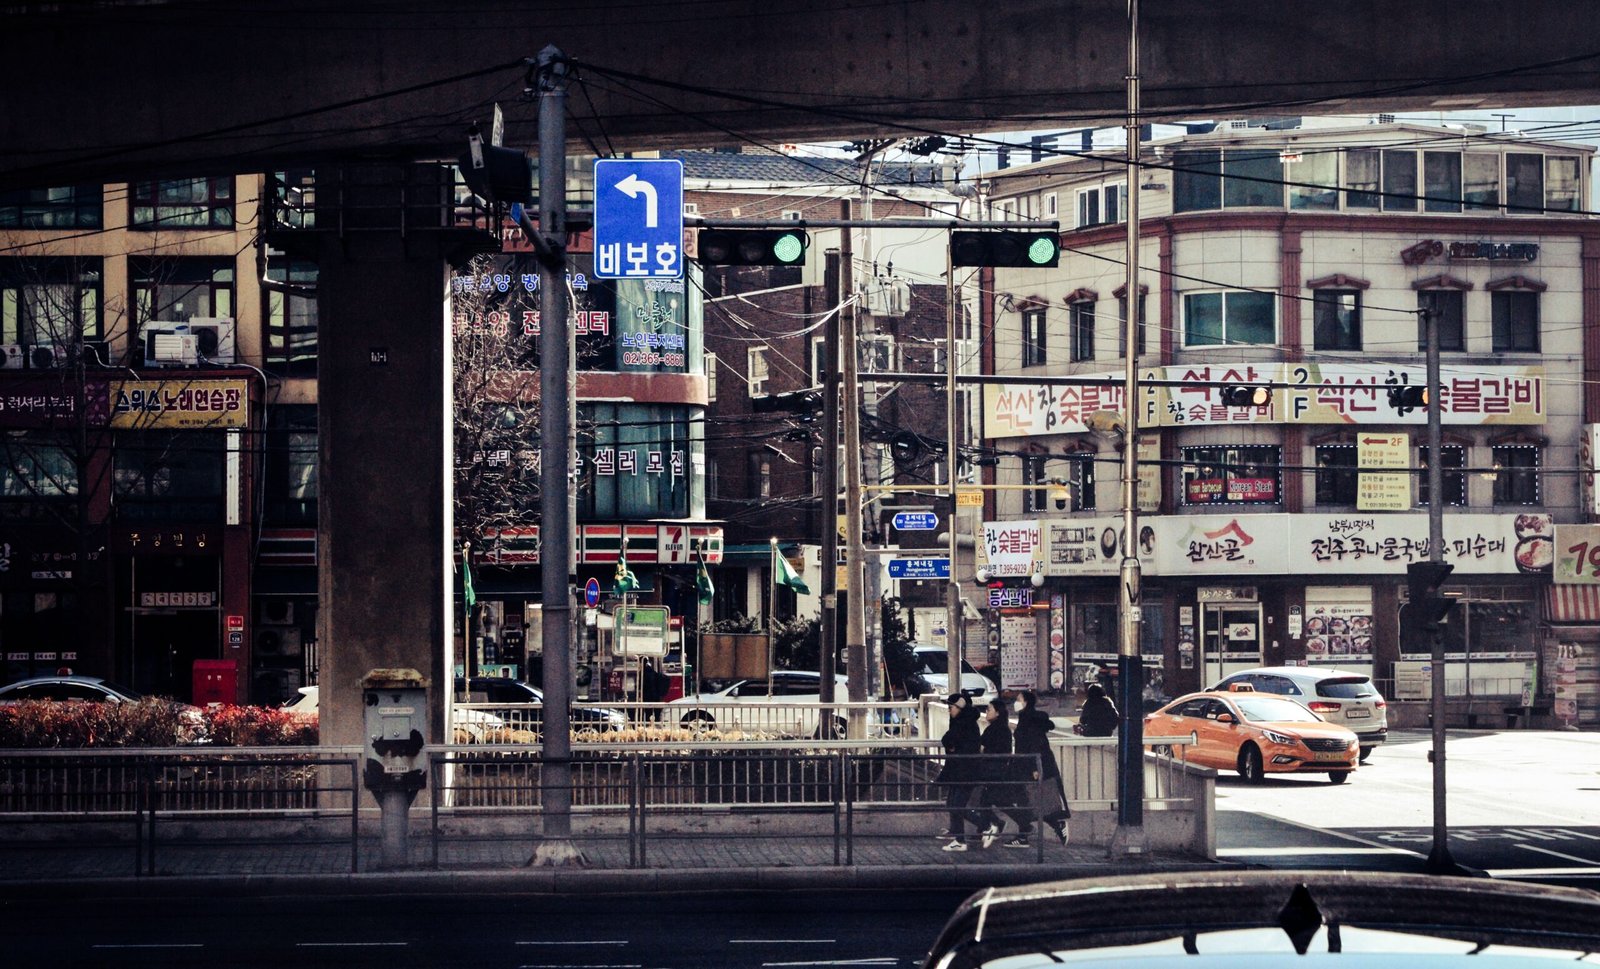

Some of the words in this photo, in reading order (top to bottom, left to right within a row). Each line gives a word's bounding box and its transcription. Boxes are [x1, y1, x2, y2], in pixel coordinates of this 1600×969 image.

[599, 242, 677, 275] 비보호
[622, 332, 684, 350] 노인복지센터
[996, 389, 1034, 429] 석산
[1391, 437, 1403, 446] 2F
[646, 450, 684, 476] 모집
[1229, 481, 1253, 493] Korean
[1255, 480, 1273, 493] Steak
[666, 526, 682, 562] 7
[1186, 538, 1245, 562] 완산골
[1452, 533, 1505, 559] 피순대
[1036, 561, 1043, 573] 2F
